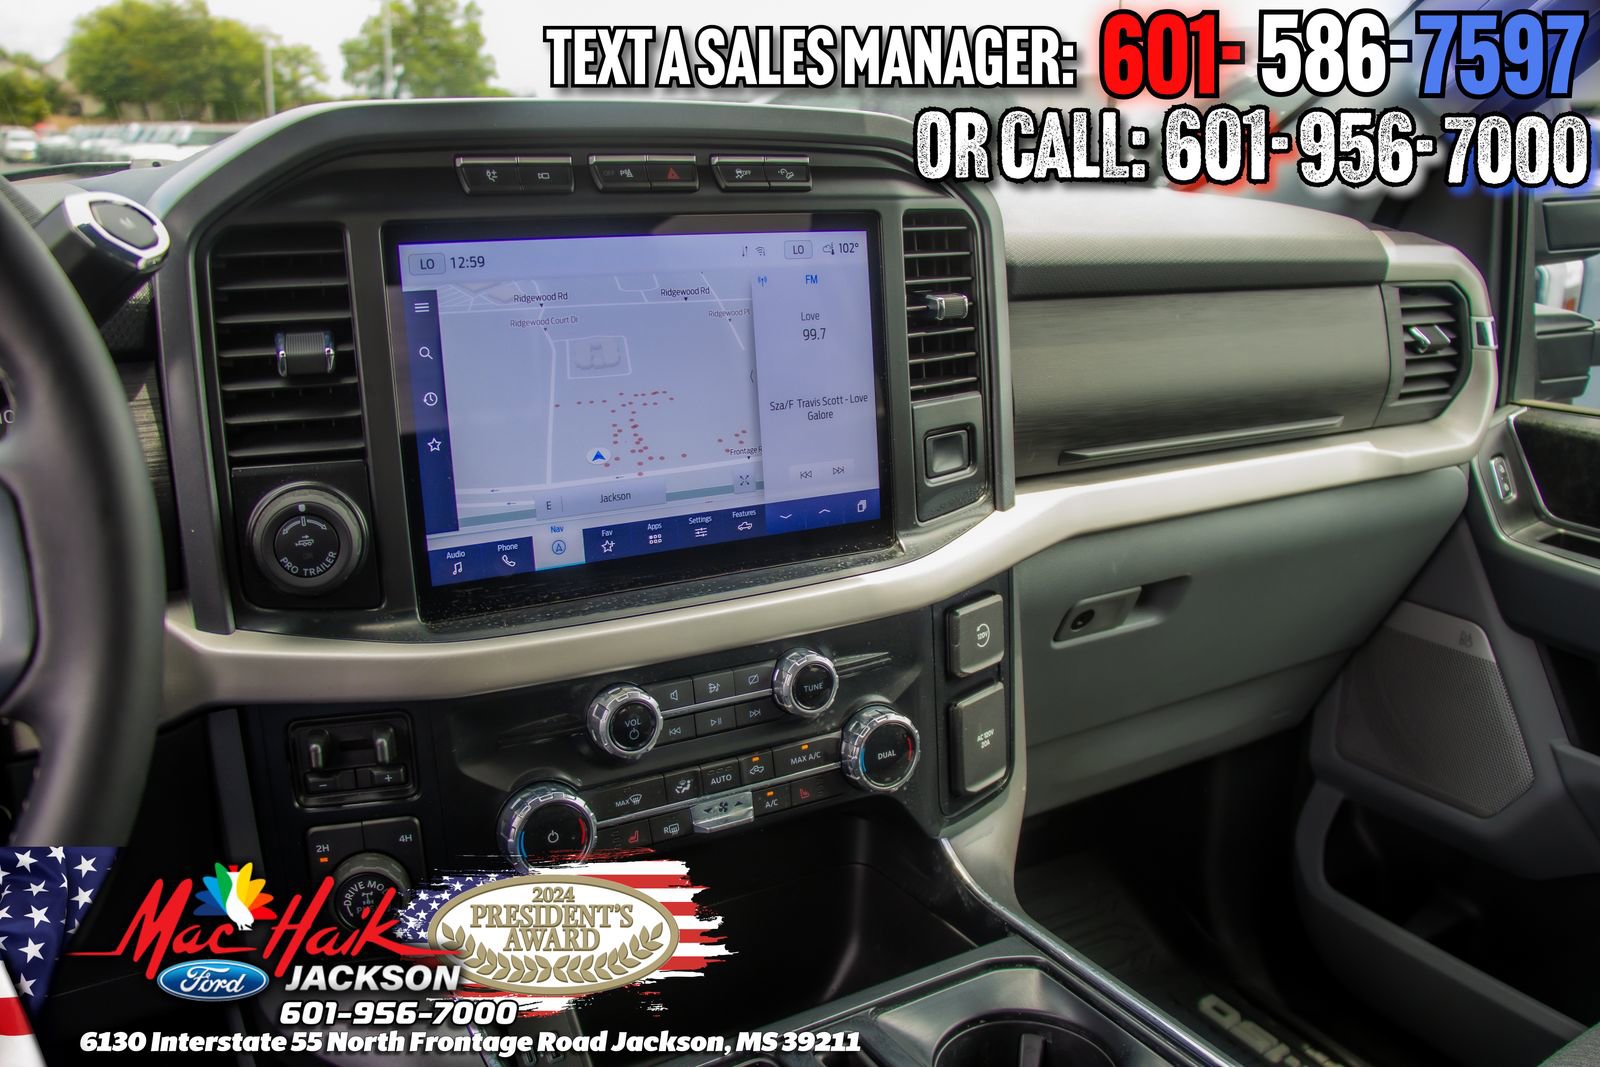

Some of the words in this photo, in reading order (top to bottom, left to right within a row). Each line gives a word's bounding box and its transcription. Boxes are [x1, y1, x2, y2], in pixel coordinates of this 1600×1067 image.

[792, 244, 805, 255] LO
[420, 258, 435, 270] LO
[450, 255, 486, 269] 12:59
[805, 274, 818, 284] FM
[660, 286, 700, 298] Ridgewood
[699, 286, 710, 295] Rd
[513, 293, 557, 305] Ridgewood
[557, 291, 569, 301] Rd
[708, 309, 743, 319] Ridgewood
[800, 311, 820, 322] Love
[510, 316, 550, 328] Ridgewood
[550, 316, 570, 326] Court
[802, 327, 827, 341] 99.7
[769, 401, 794, 412] Sza/F
[797, 397, 821, 409] Travis
[822, 395, 844, 407] Scott
[850, 393, 869, 404] Love
[807, 410, 834, 421] Galore
[599, 491, 632, 504] Jackson
[546, 501, 552, 511] E
[732, 508, 757, 519] Features
[688, 515, 713, 526] Settings
[550, 524, 564, 534] Nav
[647, 522, 663, 532] Apps
[601, 529, 614, 537] Fav
[497, 542, 519, 552] Phone
[446, 549, 466, 560] Audio
[280, 556, 299, 575] PRO
[302, 551, 337, 577] TRAILER
[803, 681, 824, 692] TUNE
[624, 718, 642, 728] VOL
[790, 755, 808, 766] MAX
[808, 751, 822, 762] A/C
[877, 749, 897, 761] DUAL
[710, 773, 733, 786] AUTO
[615, 799, 630, 808] MAX
[765, 798, 779, 808] A/C
[399, 834, 413, 843] 4H
[315, 844, 330, 853] 2H
[343, 880, 366, 907] DRIVE
